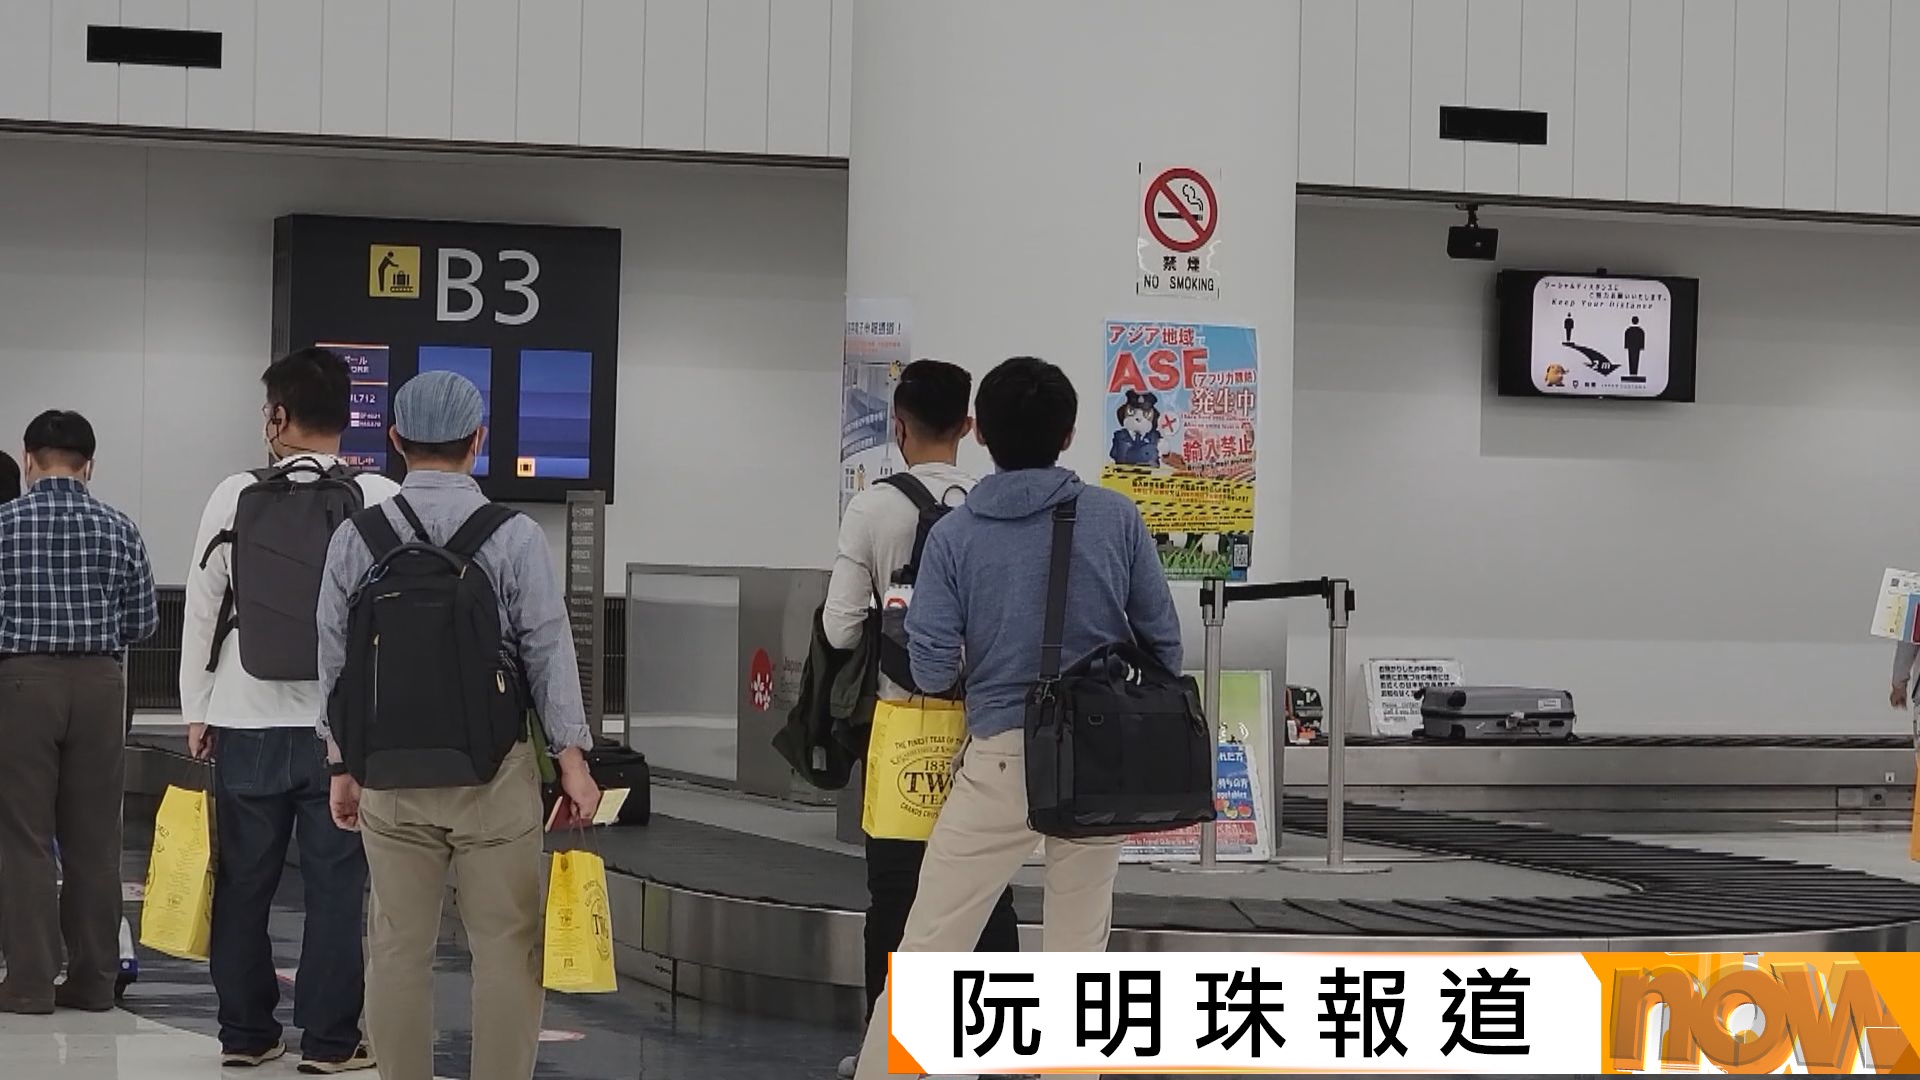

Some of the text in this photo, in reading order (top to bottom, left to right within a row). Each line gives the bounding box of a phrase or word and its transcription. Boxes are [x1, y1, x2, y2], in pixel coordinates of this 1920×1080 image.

[437, 248, 540, 325] B3
[1144, 274, 1214, 291] NO SMOKING
[1552, 299, 1575, 307] Keep
[1108, 348, 1207, 393] ASF
[1192, 387, 1255, 416] 発生中
[1183, 434, 1252, 462] 輸入禁止
[904, 772, 954, 793] TW
[1217, 791, 1247, 799] egetables
